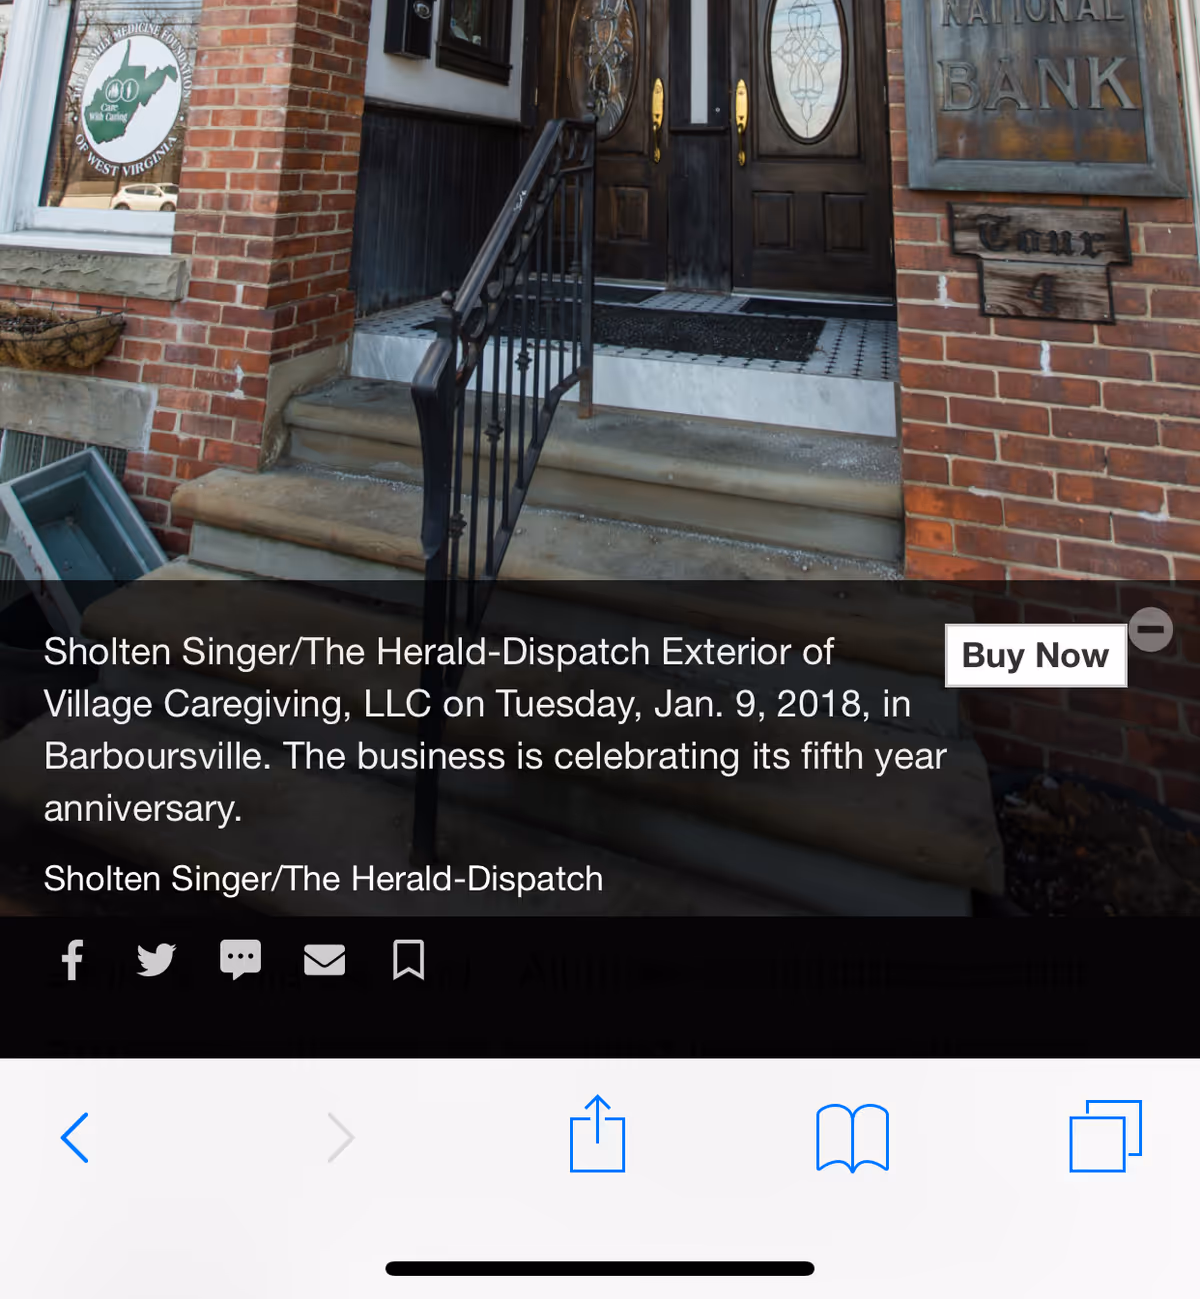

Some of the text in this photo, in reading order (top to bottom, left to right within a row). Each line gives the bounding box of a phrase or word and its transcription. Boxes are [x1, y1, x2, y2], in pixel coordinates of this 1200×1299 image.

[113, 22, 160, 41] MEDICINE
[160, 30, 192, 99] FOUNDATION
[938, 55, 1139, 113] BANK
[100, 103, 119, 112] Care
[75, 133, 178, 178] OF WEST VIRGINIA
[978, 213, 1106, 257] Tour
[1027, 273, 1057, 314] 4
